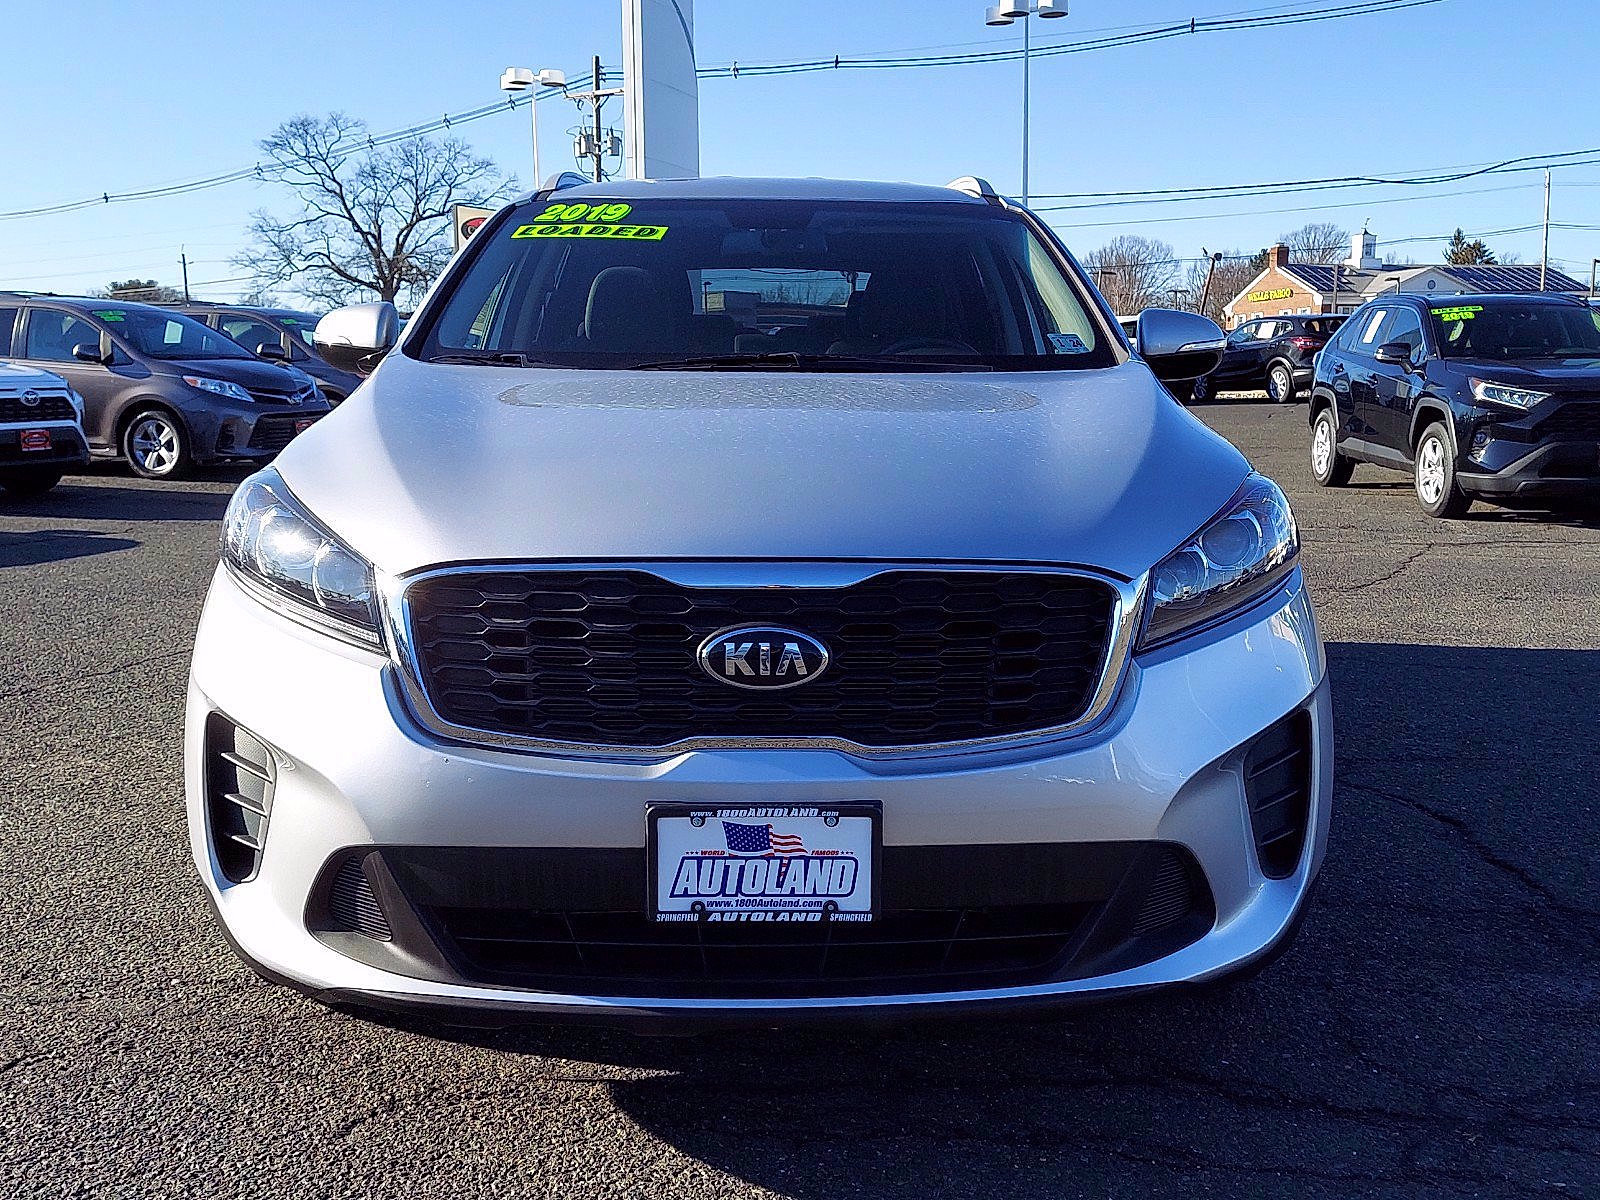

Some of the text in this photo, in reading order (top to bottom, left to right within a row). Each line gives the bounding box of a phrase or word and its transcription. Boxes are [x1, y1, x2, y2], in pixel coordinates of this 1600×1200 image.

[533, 203, 633, 222] 2019
[515, 225, 662, 238] LOADED
[1248, 288, 1292, 302] WELLS FARGO
[723, 642, 808, 676] KIA
[670, 857, 858, 897] AUTOLAND
[706, 899, 823, 909] www.1800Autoland.com
[656, 912, 873, 922] SPRINGFIELD AUTOLAND SPRINGFIELD
